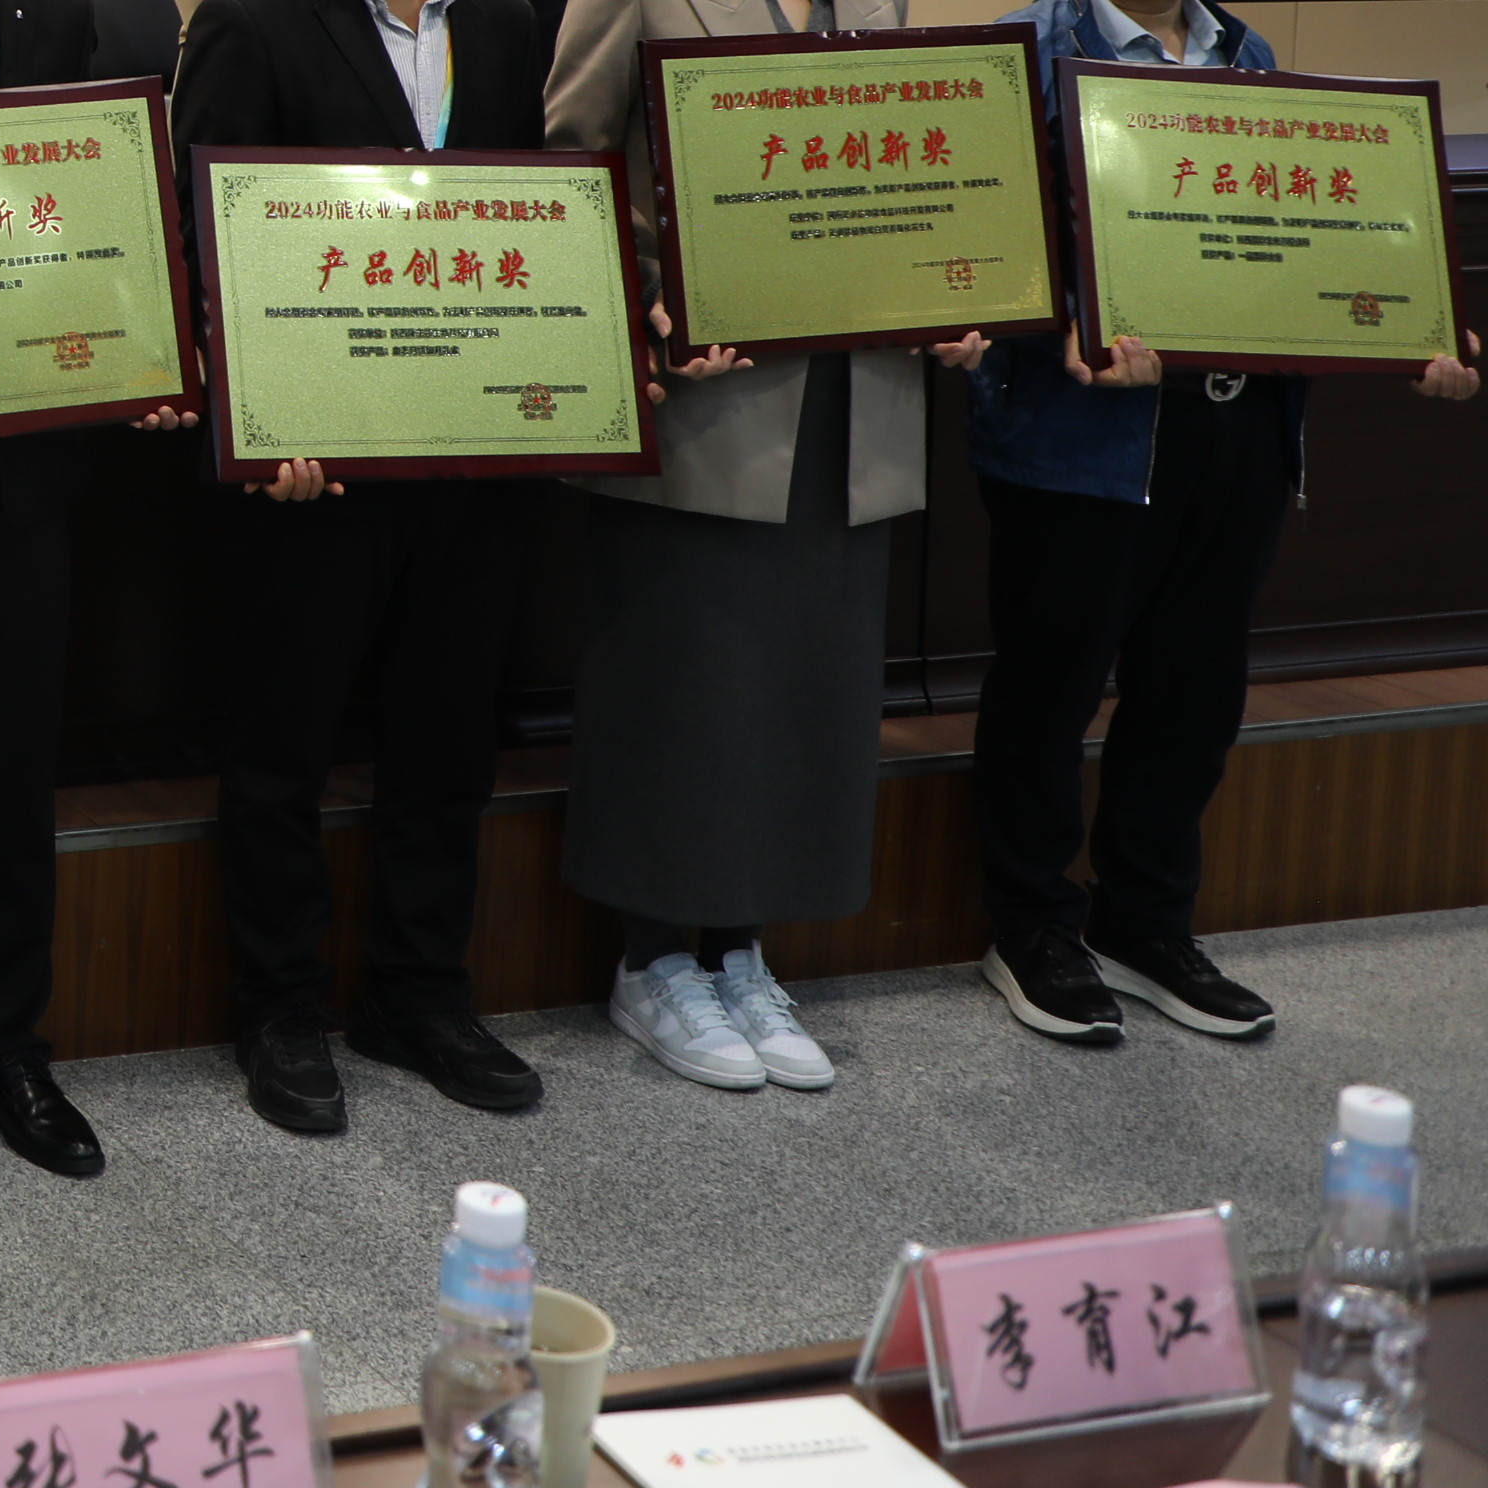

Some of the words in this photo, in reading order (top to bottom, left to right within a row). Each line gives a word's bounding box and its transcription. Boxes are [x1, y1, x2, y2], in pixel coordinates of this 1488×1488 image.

[711, 77, 984, 111] 2024功能农业与食品产业发展大会
[1126, 112, 1389, 144] 2024功能农业与食品产业发展大会
[761, 126, 952, 181] 产品创新奖
[1172, 156, 1359, 205] 产品创新奖
[264, 199, 566, 223] 2024功能农业与食品产业发展大会
[318, 245, 531, 293] 产品创新奖
